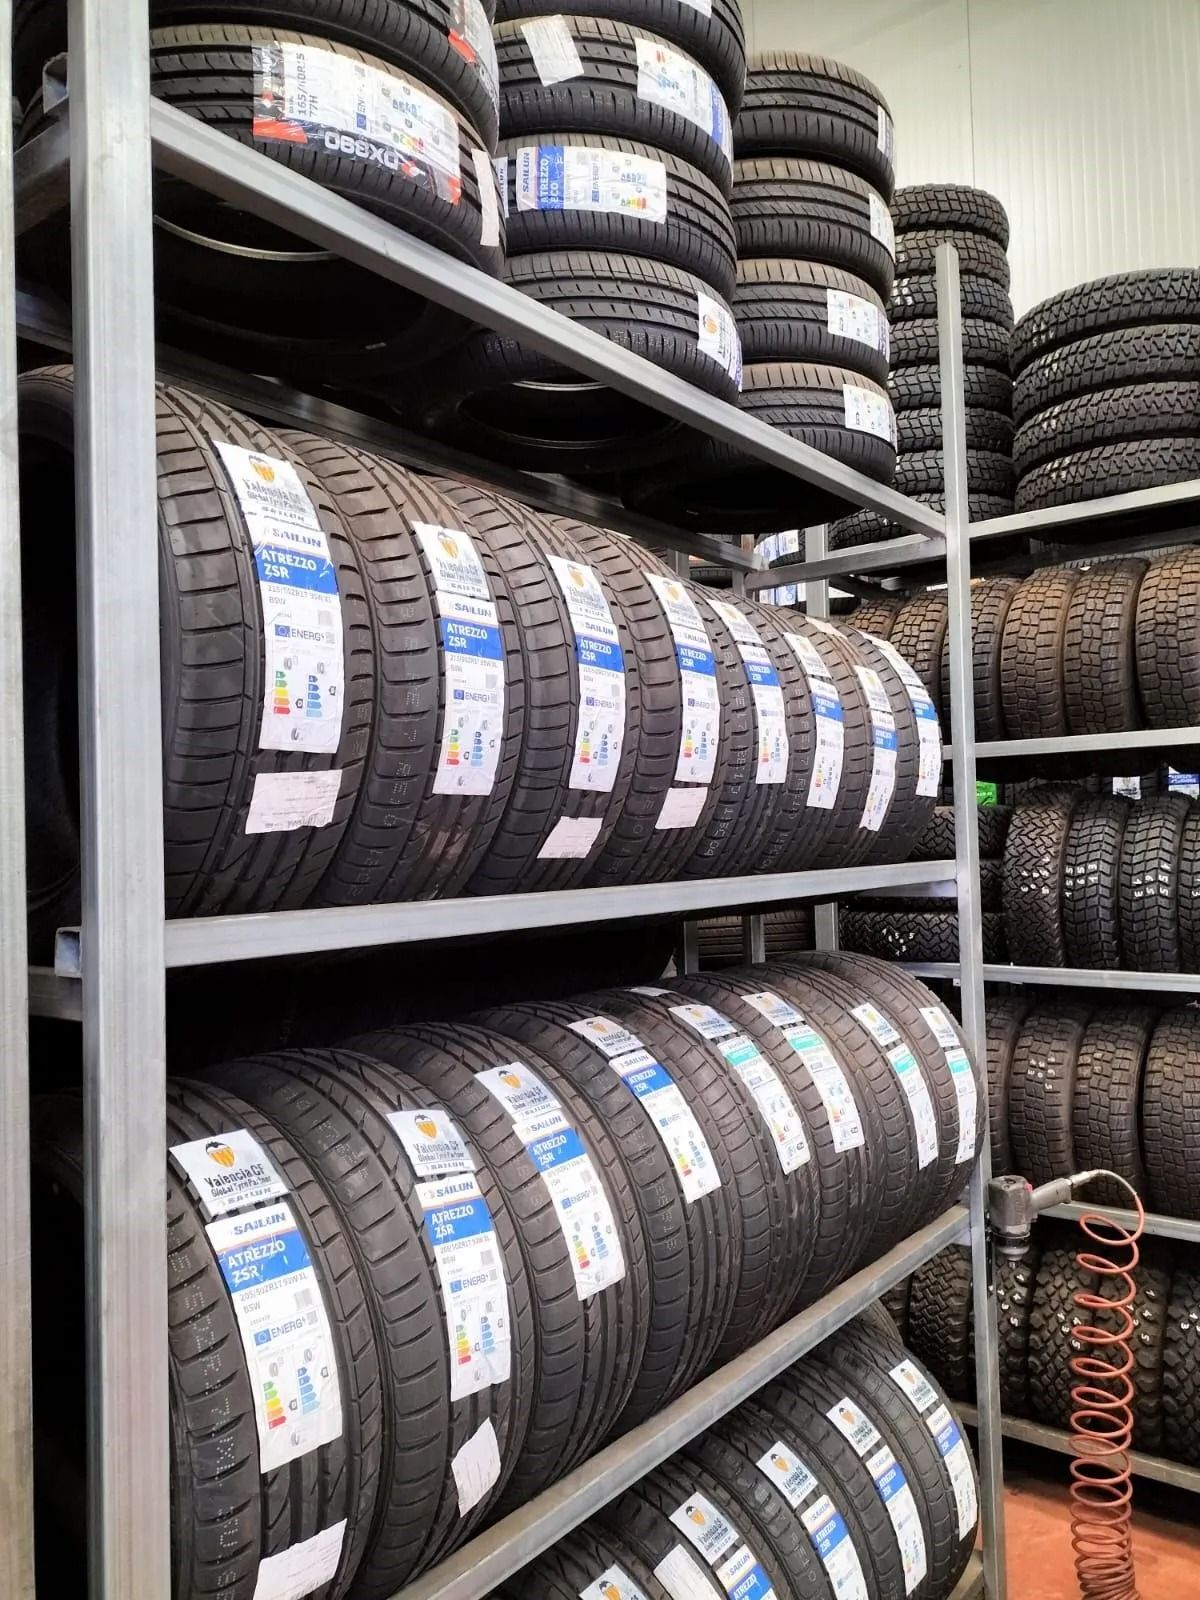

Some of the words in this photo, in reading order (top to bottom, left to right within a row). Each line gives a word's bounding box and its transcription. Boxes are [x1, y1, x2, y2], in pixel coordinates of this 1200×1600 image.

[522, 152, 531, 193] SAILUN
[539, 156, 550, 204] ATREZZO
[549, 182, 559, 203] ECO
[272, 528, 322, 548] SAILUN
[262, 549, 317, 571] ATREZZO
[264, 563, 290, 579] ZSR
[454, 602, 492, 618] SAILUN
[447, 623, 488, 640] ATREZZO
[449, 636, 467, 648] ZSR
[580, 638, 612, 655] ATREZZO
[582, 650, 596, 662] ZSR
[1064, 865, 1074, 898] 155
[1076, 866, 1085, 885] 65
[1088, 864, 1098, 883] 13
[1159, 863, 1172, 897] 155
[1132, 878, 1144, 898] 13
[1145, 874, 1155, 895] 65
[530, 1116, 562, 1132] SAILUN
[534, 1135, 567, 1156] ATREZZO
[538, 1153, 555, 1166] ZSR
[204, 1168, 252, 1188] Valencia
[250, 1164, 264, 1176] CF
[211, 1184, 234, 1198] Global
[436, 1182, 474, 1198] SAILUN
[234, 1212, 286, 1235] SAILUN
[432, 1204, 474, 1226] ATREZZO
[434, 1225, 454, 1239] ZSR
[228, 1239, 286, 1269] ATREZZO
[232, 1265, 261, 1284] ZSR
[1056, 1312, 1070, 1334] 13
[816, 1520, 836, 1543] ATREZZO
[729, 1552, 750, 1576] SAILUN
[734, 1574, 757, 1600] ATREZZO
